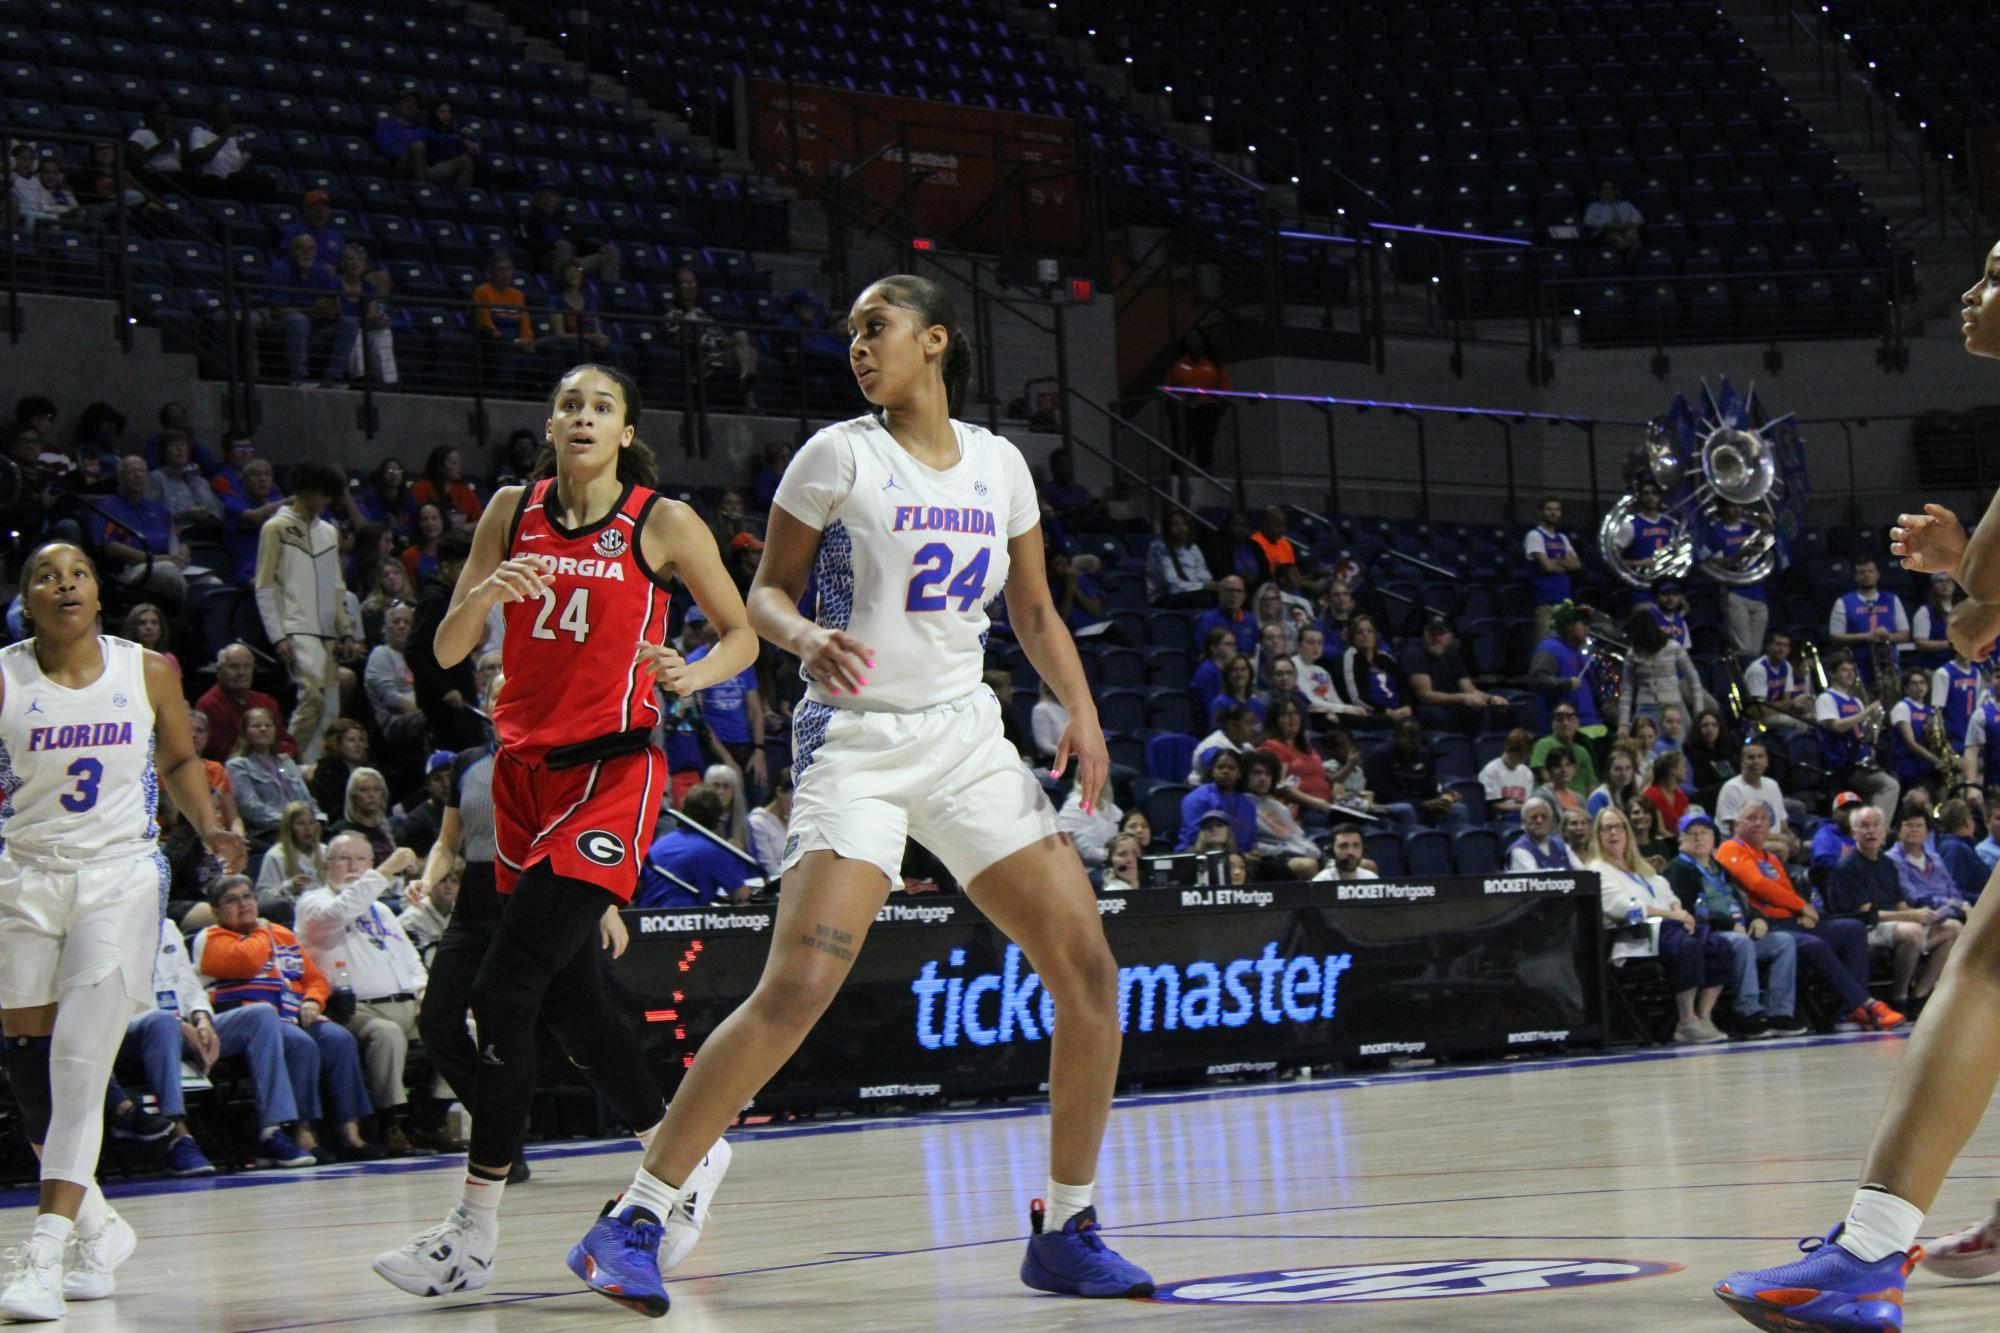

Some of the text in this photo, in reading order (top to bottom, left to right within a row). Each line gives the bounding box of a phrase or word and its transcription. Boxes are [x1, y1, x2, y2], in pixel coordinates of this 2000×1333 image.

[892, 506, 996, 537] FLORIDA
[600, 529, 622, 549] SEC
[514, 552, 625, 581] ORGIA
[905, 542, 991, 612] 24
[531, 586, 590, 643] 24
[27, 722, 132, 752] FLORIDA
[60, 757, 103, 813] 3
[1338, 884, 1385, 900] ROCKET
[1483, 878, 1528, 893] ROCKET
[1182, 891, 1232, 907] ROET
[640, 913, 770, 933] ROCKET Mortgage
[894, 905, 955, 923] Mortgage
[911, 941, 1351, 1050] tickmaster
[860, 1085, 899, 1098] ROCKET
